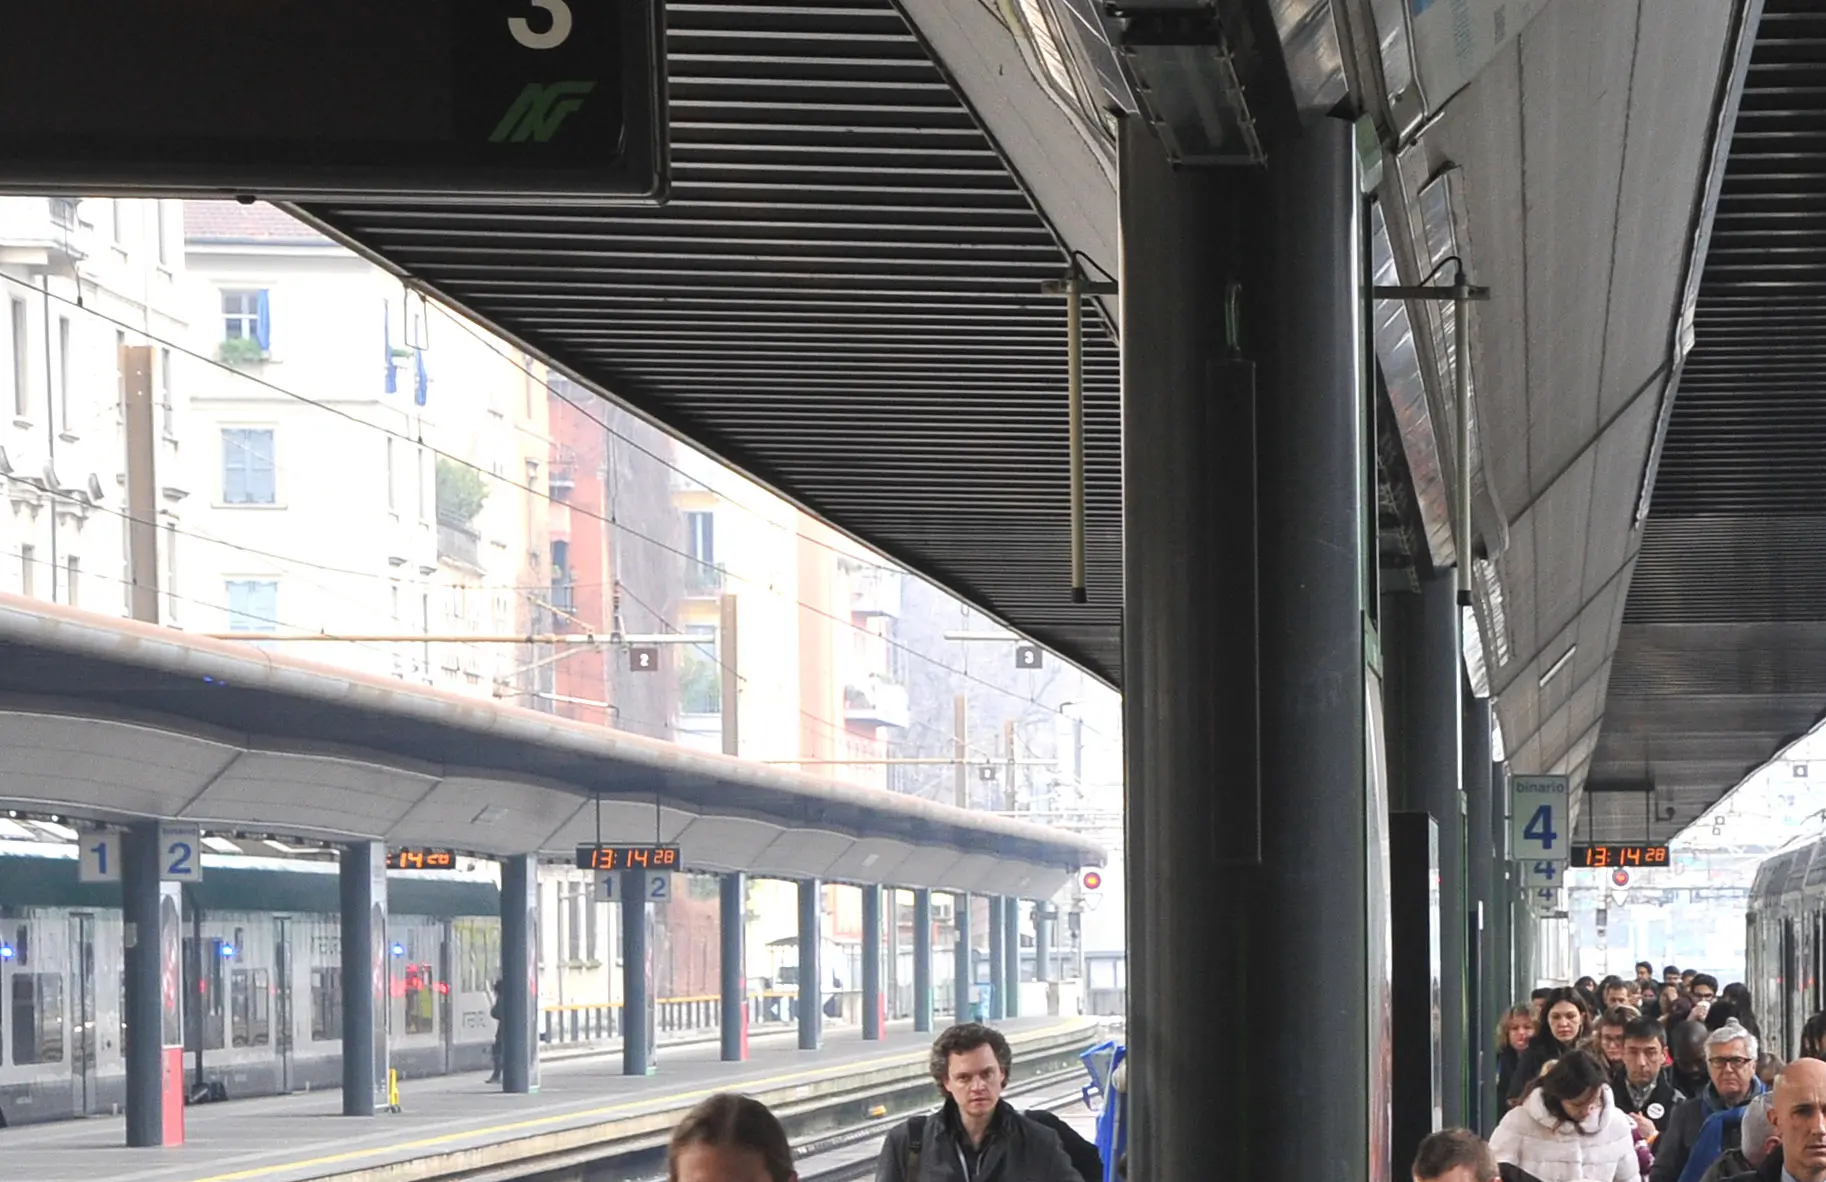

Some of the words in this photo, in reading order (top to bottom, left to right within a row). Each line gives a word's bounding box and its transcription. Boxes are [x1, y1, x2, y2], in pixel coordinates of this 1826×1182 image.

[507, 0, 573, 50] 3
[640, 653, 649, 667] 2
[1025, 651, 1034, 664] 3
[1516, 781, 1565, 794] binario
[1523, 804, 1558, 850] 4
[90, 842, 107, 874] 1
[167, 842, 192, 874] 2
[654, 849, 675, 864] 28
[1645, 847, 1666, 862] 28
[1534, 861, 1556, 880] 4
[602, 876, 614, 898] 1
[651, 877, 667, 897] 2
